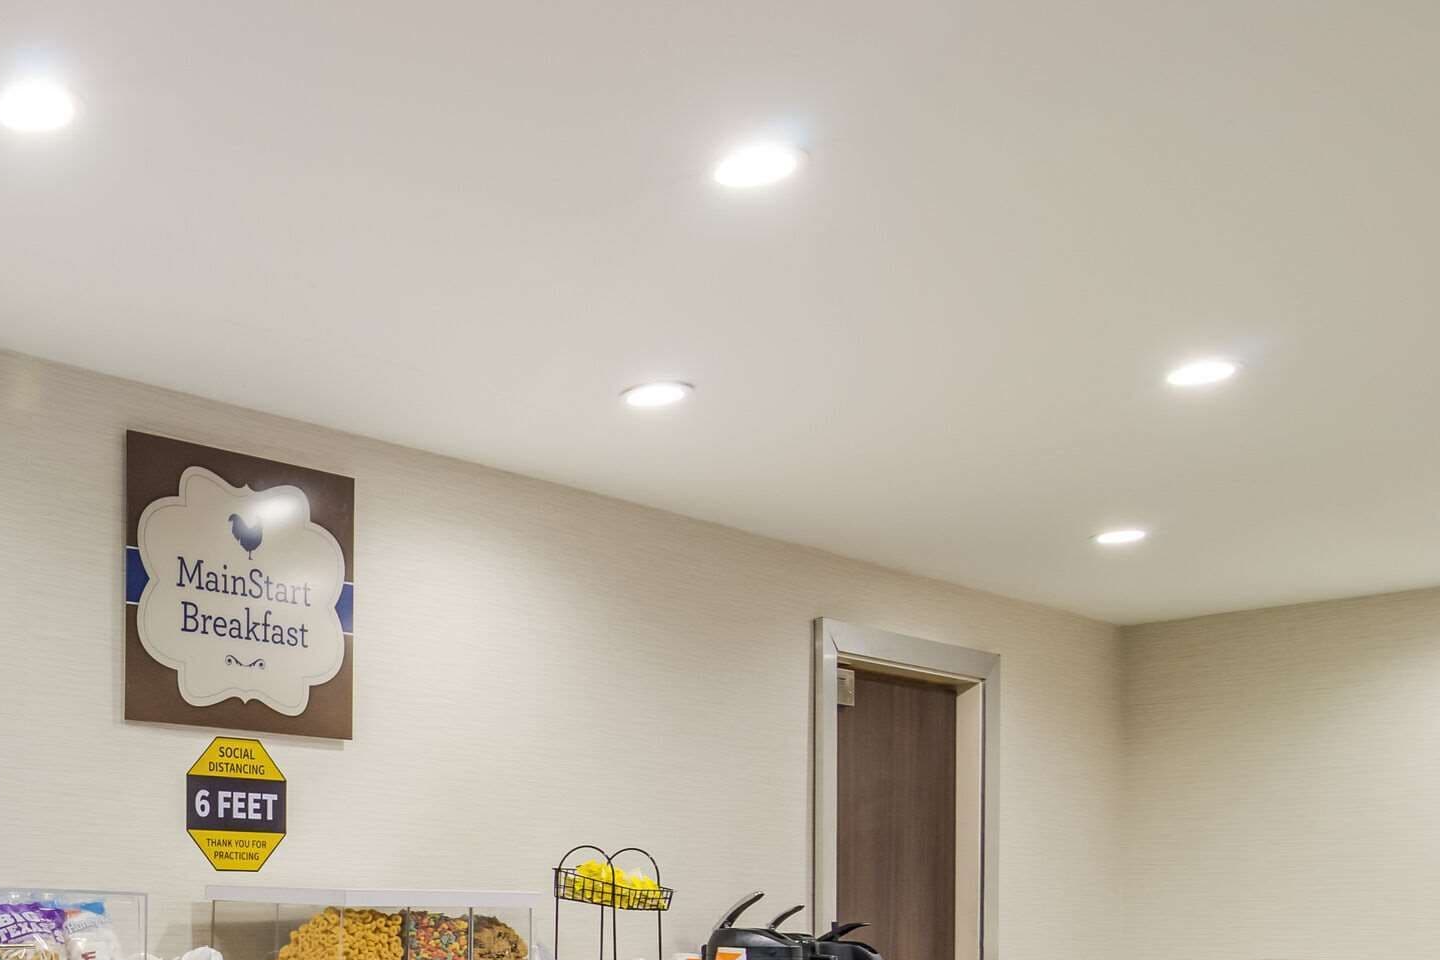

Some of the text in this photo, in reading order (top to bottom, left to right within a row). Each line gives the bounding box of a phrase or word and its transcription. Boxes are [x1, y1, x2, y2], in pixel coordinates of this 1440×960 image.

[176, 556, 312, 607] MainStart
[181, 601, 308, 648] Breakfast
[218, 746, 256, 760] SOCIAL
[208, 761, 265, 776] DISTANCING
[195, 789, 278, 820] 6 FEET
[206, 838, 266, 849] THANK YOU FOR
[214, 851, 260, 861] PRACTICING
